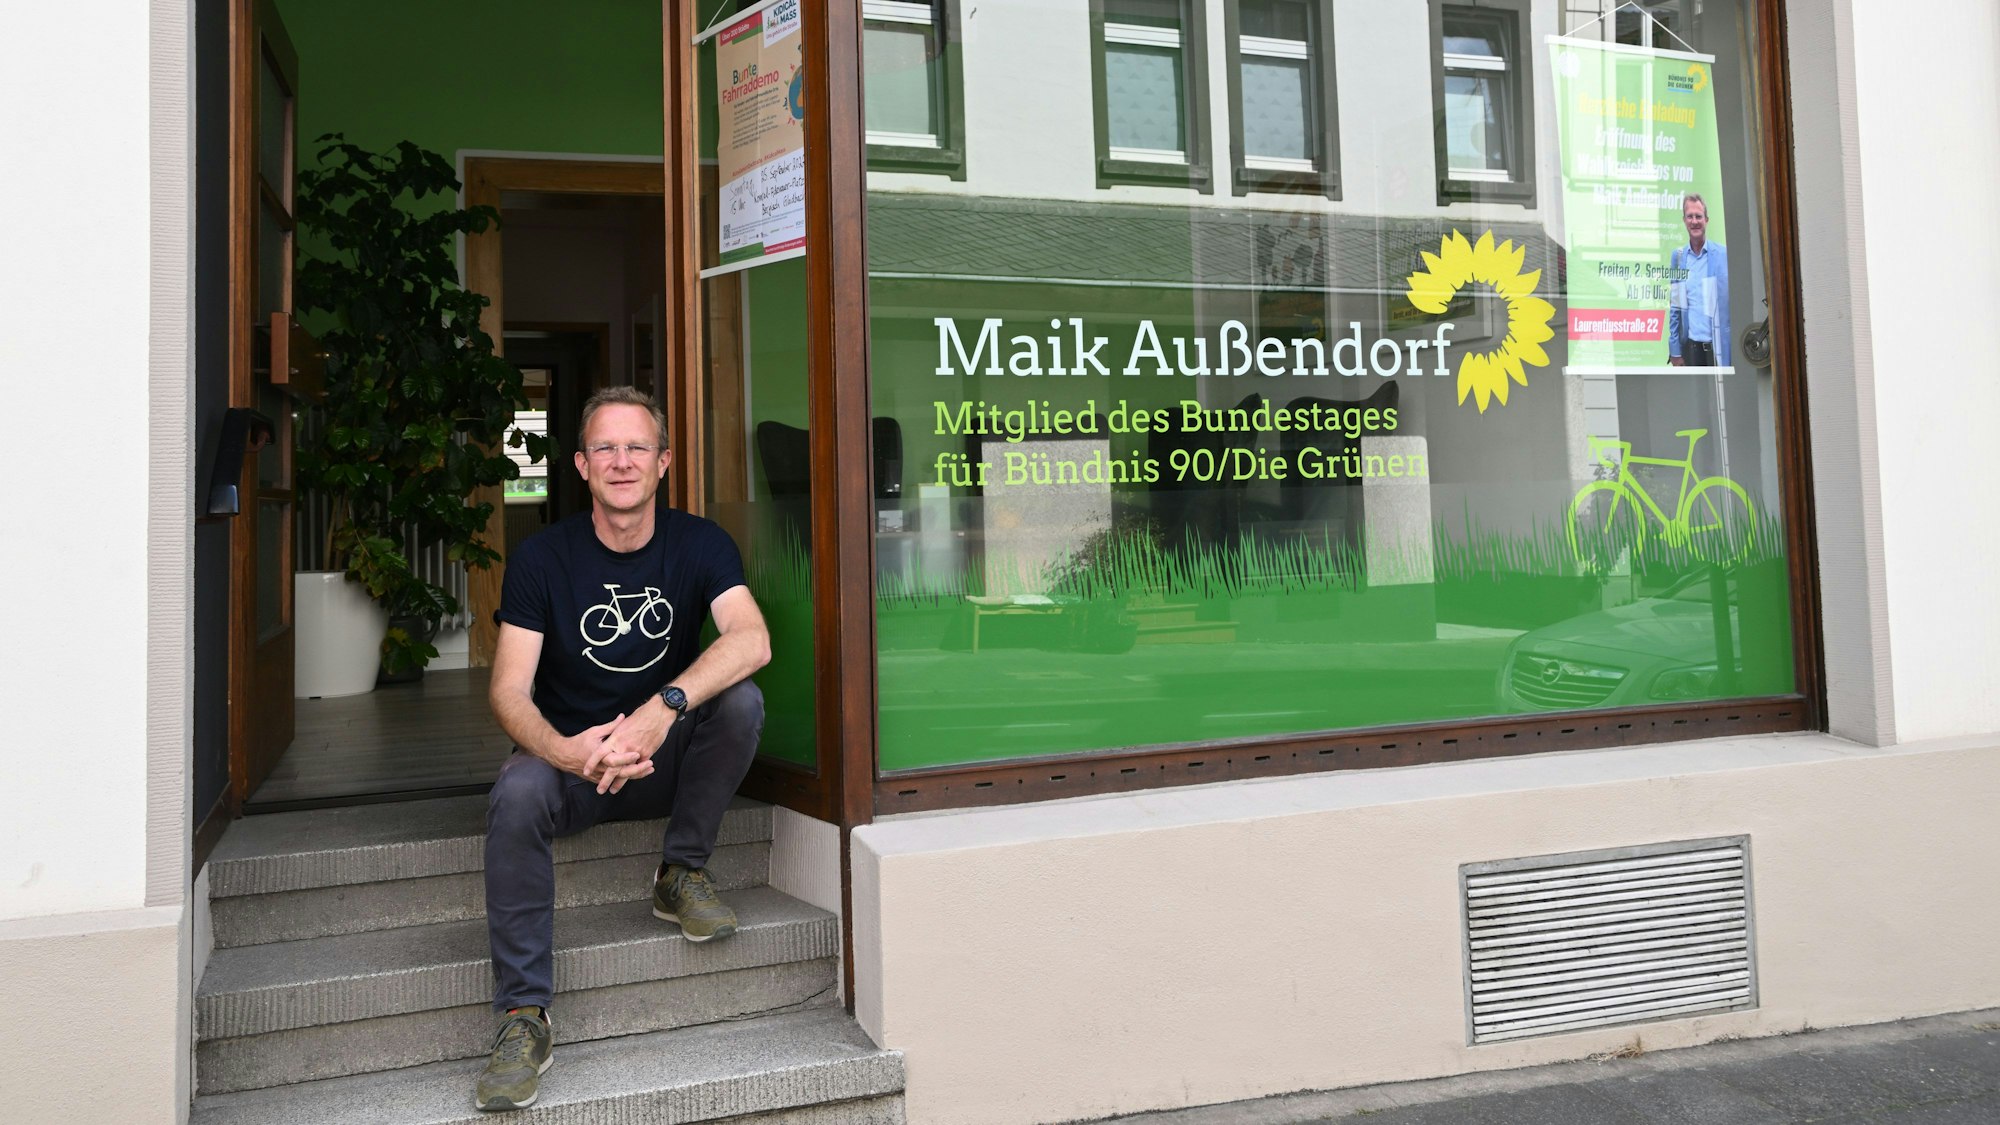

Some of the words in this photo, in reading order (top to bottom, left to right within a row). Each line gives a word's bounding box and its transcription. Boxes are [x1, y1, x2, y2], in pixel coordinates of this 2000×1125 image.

[773, 0, 796, 18] KIDICAL
[780, 9, 797, 25] MASS
[738, 23, 750, 34] Städte
[732, 62, 757, 85] Bunte
[1667, 74, 1686, 83] BÜNDNIS
[1686, 75, 1694, 83] 90
[722, 69, 780, 105] Fahrraddemo
[1639, 97, 1697, 129] Einladung
[1594, 123, 1652, 155] Eröffnung
[1655, 131, 1676, 153] des
[1672, 166, 1694, 182] von
[1593, 184, 1623, 206] Maik
[1625, 188, 1685, 210] Außendorf
[1598, 261, 1632, 281] Freitag,
[1634, 263, 1642, 278] 2.
[1645, 263, 1690, 282] September
[1626, 284, 1638, 299] Ab
[1641, 284, 1651, 300] 16
[1653, 284, 1668, 300] Uhr
[1574, 316, 1645, 333] Laurentiusstraße
[1647, 317, 1659, 333] 22
[934, 317, 1110, 377] Maik
[1123, 319, 1455, 377] Außendorf
[933, 400, 1099, 444] Mitglied
[1107, 399, 1170, 434] des
[1179, 399, 1398, 439] Bundestages
[933, 451, 993, 487] für
[1004, 447, 1160, 486] Bündnis
[1169, 446, 1288, 484] 90/Die
[1297, 446, 1426, 479] Grünen
